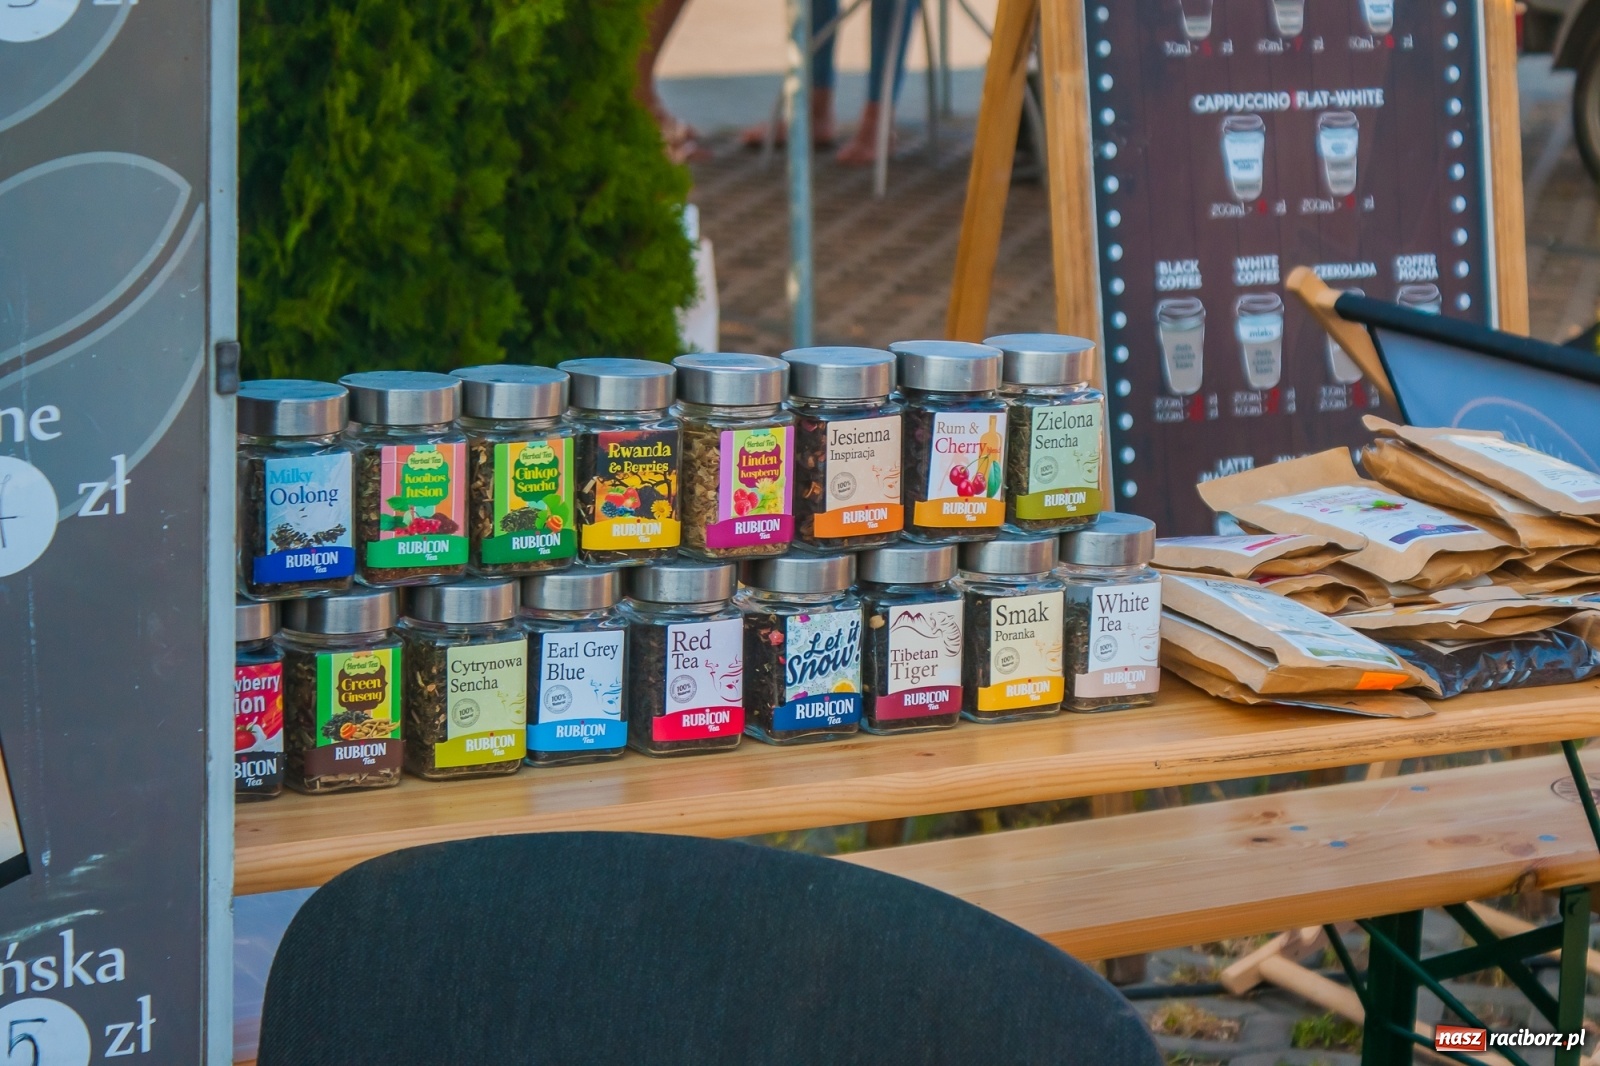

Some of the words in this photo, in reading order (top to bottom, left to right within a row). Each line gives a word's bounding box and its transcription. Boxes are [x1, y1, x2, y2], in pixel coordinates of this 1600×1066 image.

[1194, 92, 1290, 112] CAPPUCCINO
[1296, 88, 1384, 108] FLAT-WHITE
[1157, 259, 1199, 275] BLACK
[1235, 255, 1278, 271] WHITE
[1396, 254, 1437, 268] COFFEE
[1235, 270, 1280, 286] COFFEE
[1314, 262, 1377, 280] CZEKOLADA
[1398, 267, 1438, 281] MOCHA
[1157, 275, 1202, 290] COFFEE
[937, 421, 966, 435] Rum
[969, 422, 980, 434] &
[1036, 411, 1093, 431] Zielona
[747, 440, 765, 448] Herbal
[766, 439, 775, 447] Tea
[830, 429, 890, 447] Jesienna
[1035, 434, 1079, 450] Sencha
[521, 451, 541, 460] Herbal
[608, 441, 672, 459] Rwanda
[830, 449, 875, 462] Inspiracja
[935, 437, 987, 459] Cherry
[410, 456, 430, 465] Herbal
[609, 463, 621, 473] &
[624, 460, 669, 473] Berries
[742, 454, 777, 467] Linden
[1219, 456, 1254, 472] LATTE
[269, 469, 313, 485] Milky
[515, 466, 558, 482] Ginkgo
[77, 454, 131, 517] zł
[516, 480, 557, 493] Sencha
[837, 480, 851, 489] 100%
[269, 486, 338, 506] Oolong
[1044, 491, 1086, 507] RUBICON
[843, 507, 888, 524] RUBICON
[942, 501, 987, 516] RUBICON
[1066, 504, 1077, 512] Tea
[867, 521, 879, 529] Tea
[965, 514, 977, 522] Tea
[612, 521, 661, 537] RUBICON
[735, 518, 780, 535] RUBICON
[512, 532, 561, 550] RUBICON
[638, 535, 651, 543] Tea
[759, 532, 771, 540] Tea
[397, 539, 450, 555] RUBICON
[538, 547, 551, 555] Tea
[285, 550, 339, 569] RUBICON
[424, 552, 438, 561] Tea
[314, 565, 327, 574] Tea
[1097, 594, 1149, 615] White
[995, 601, 1049, 626] Smak
[1098, 617, 1122, 632] Tea
[671, 629, 712, 652] Red
[804, 628, 842, 660] Let
[848, 620, 860, 644] it
[995, 629, 1035, 642] Poranka
[547, 642, 579, 659] Earl
[583, 641, 619, 661] Grey
[890, 648, 939, 663] Tibetan
[347, 662, 367, 670] Herbal
[451, 656, 522, 676] Cytrynowa
[671, 653, 700, 670] Tea
[547, 664, 585, 681] Blue
[890, 662, 939, 685] Tiger
[1104, 669, 1146, 685] RUBICON
[341, 678, 382, 692] Green
[451, 677, 499, 693] Sencha
[677, 683, 691, 692] 100%
[1006, 681, 1050, 697] RUBICON
[1126, 682, 1136, 690] Tea
[341, 691, 383, 703] Ginseng
[551, 693, 566, 702] 100%
[904, 689, 949, 706] RUBICON
[459, 706, 474, 716] 100%
[795, 698, 854, 720] RUBICON
[928, 703, 940, 711] Tea
[682, 710, 730, 728] RUBICON
[827, 715, 842, 725] Tea
[556, 722, 606, 738] RUBICON
[708, 724, 721, 733] Tea
[465, 734, 515, 752] RUBICON
[582, 736, 595, 744] Tea
[335, 742, 387, 761] RUBICON
[492, 748, 505, 756] Tea
[362, 757, 376, 766] Tea
[246, 777, 263, 787] Tea
[104, 994, 157, 1058] zł
